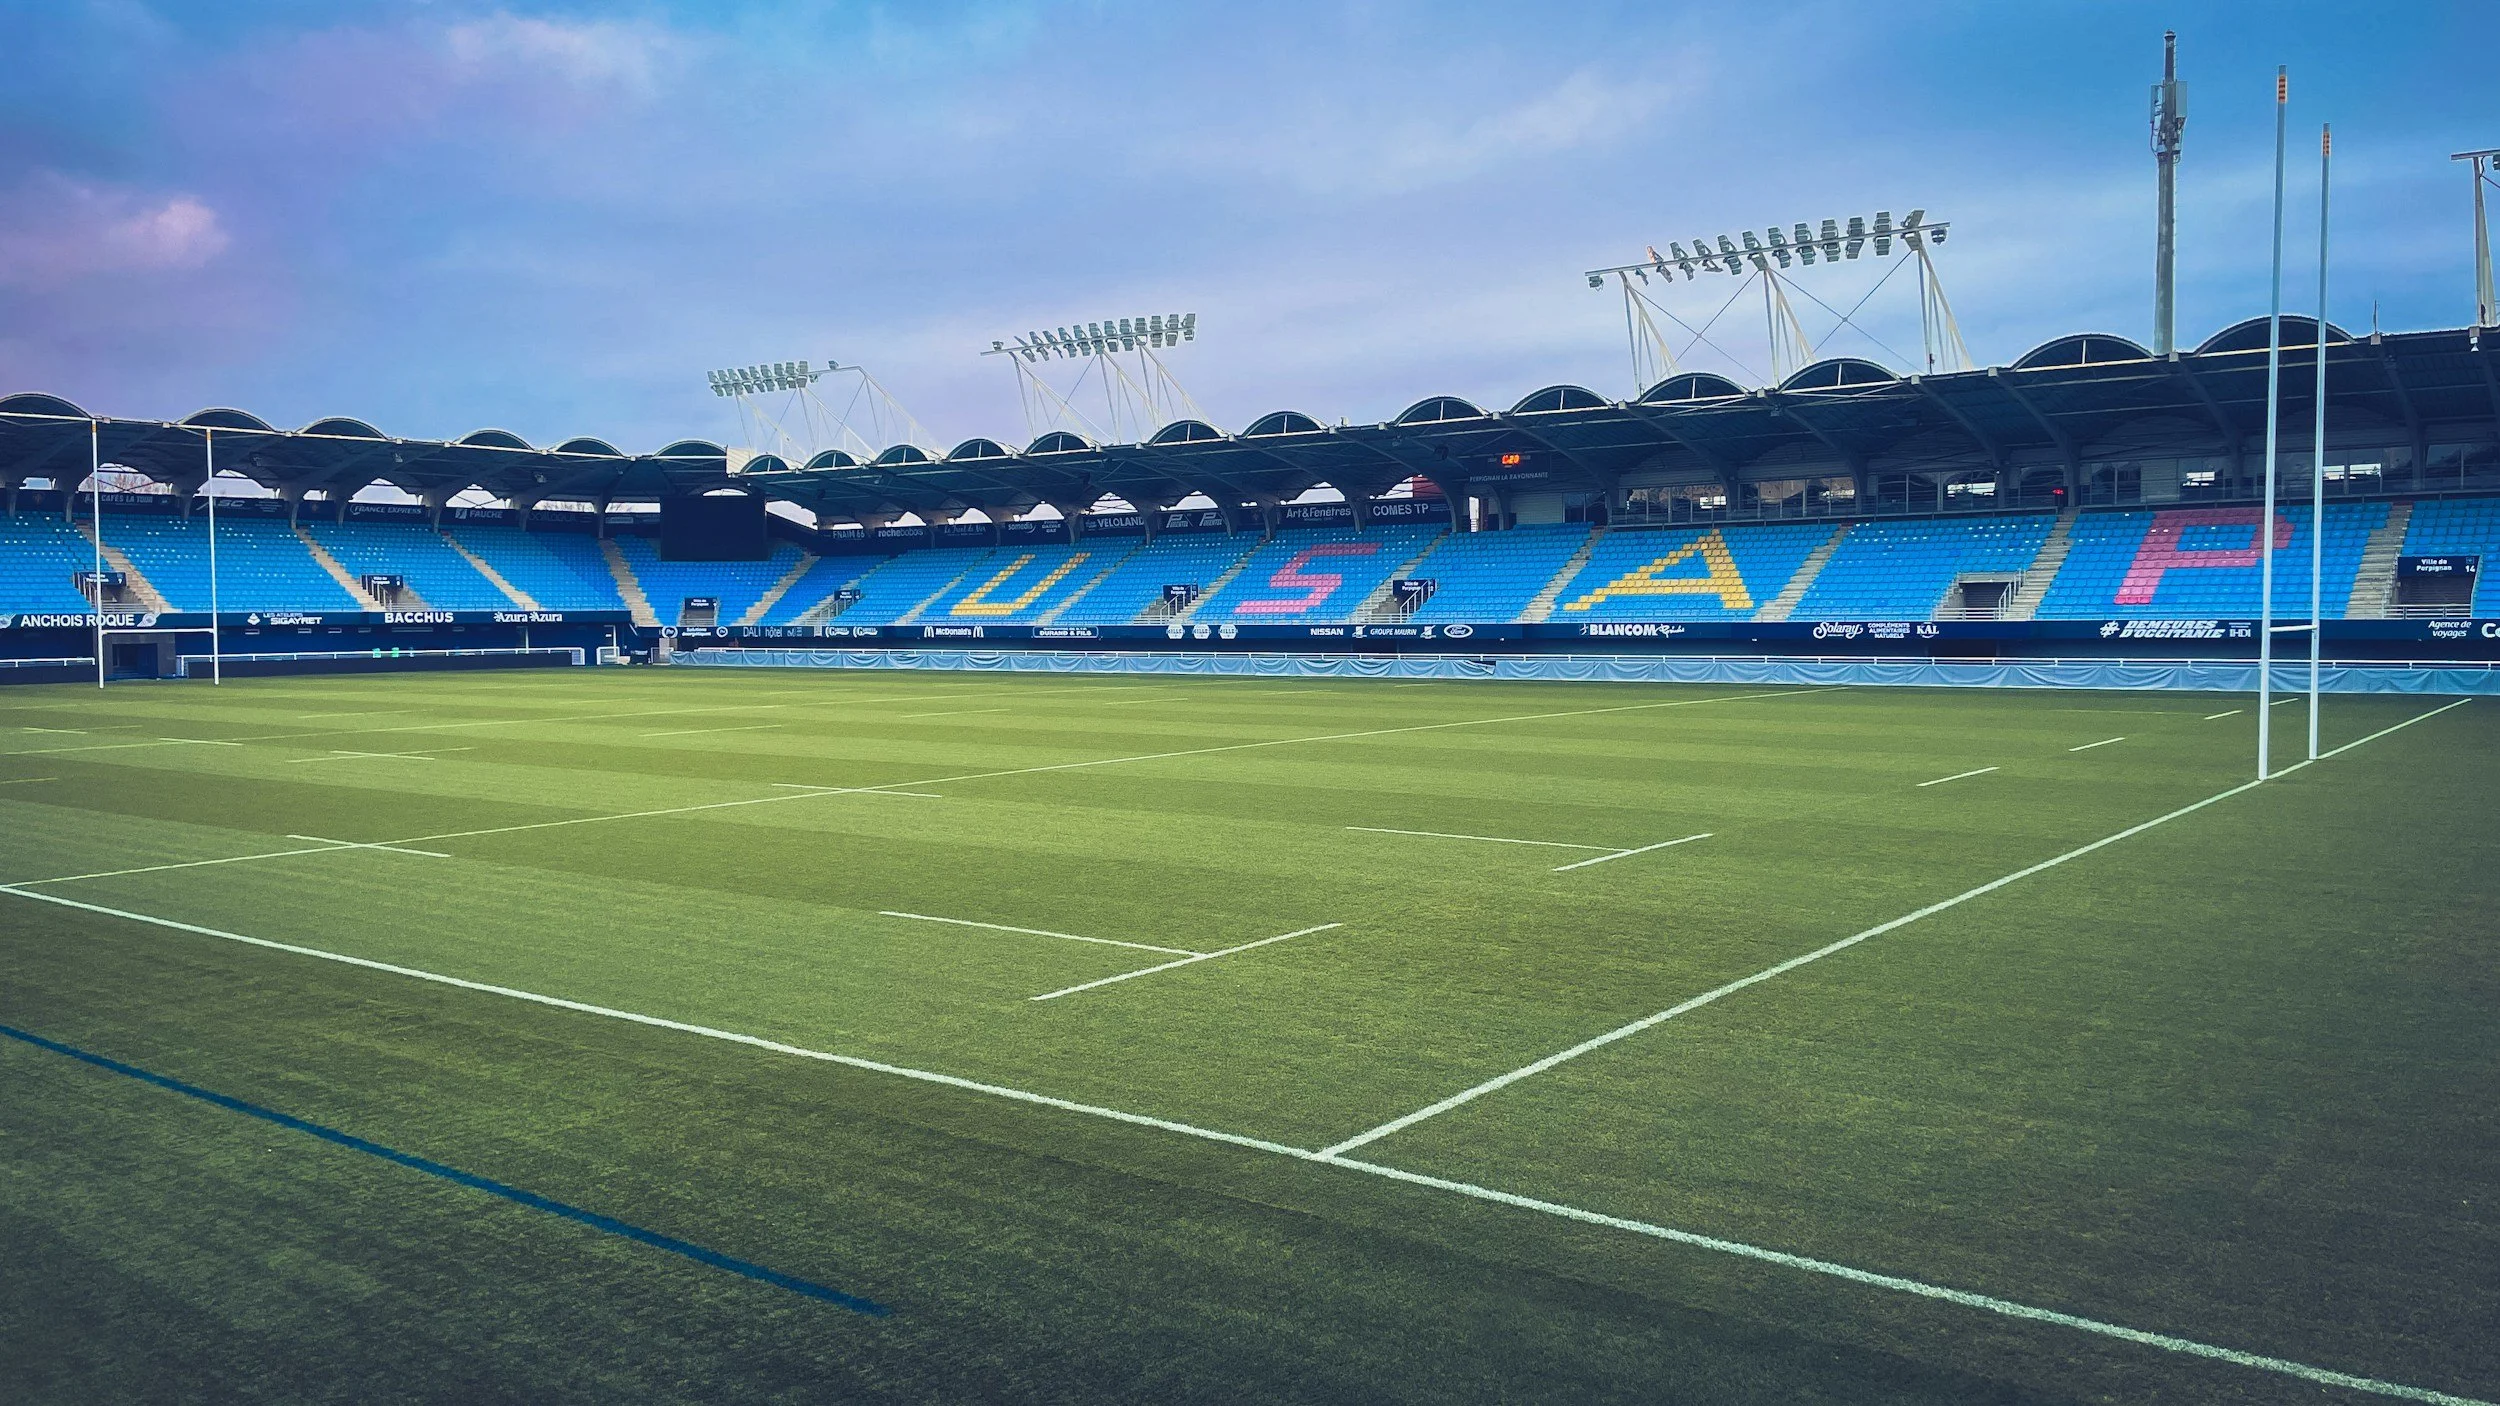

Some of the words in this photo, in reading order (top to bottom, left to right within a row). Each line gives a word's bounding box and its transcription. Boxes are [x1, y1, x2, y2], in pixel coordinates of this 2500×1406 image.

[126, 495, 134, 503] LA
[136, 495, 153, 504] TOUR
[353, 505, 385, 513] FRANCE
[387, 507, 422, 515] EXPRESS
[1372, 504, 1413, 516] COMES
[1414, 503, 1429, 514] TP
[1097, 516, 1144, 527] VELOLAND
[833, 531, 856, 539] FNAIM
[2113, 507, 2295, 605] P
[1563, 528, 1754, 610] A
[2416, 565, 2453, 573] Perpignan
[2465, 565, 2476, 573] 14
[1232, 542, 1383, 614] S
[20, 614, 83, 627] ANCHOIS
[86, 614, 135, 627] ROQUE
[270, 616, 322, 625] SIGAYRET
[384, 612, 454, 623] BACCHUS
[494, 611, 527, 622] Azura
[530, 612, 562, 622] Azura
[1916, 624, 1939, 635] KAL
[2123, 620, 2218, 629] DEMEURES
[2428, 620, 2460, 630] Agence
[765, 626, 783, 638] hôtel
[935, 627, 972, 636] McDonald's
[1310, 628, 1344, 636] NISSAN
[1370, 628, 1393, 636] GROUPE
[1394, 628, 1417, 636] MAURIN
[1589, 624, 1657, 636] BLANCOM
[1813, 621, 1863, 639] Solaray
[2119, 629, 2226, 638] D'OCCITANIE
[2432, 630, 2467, 639] voyages
